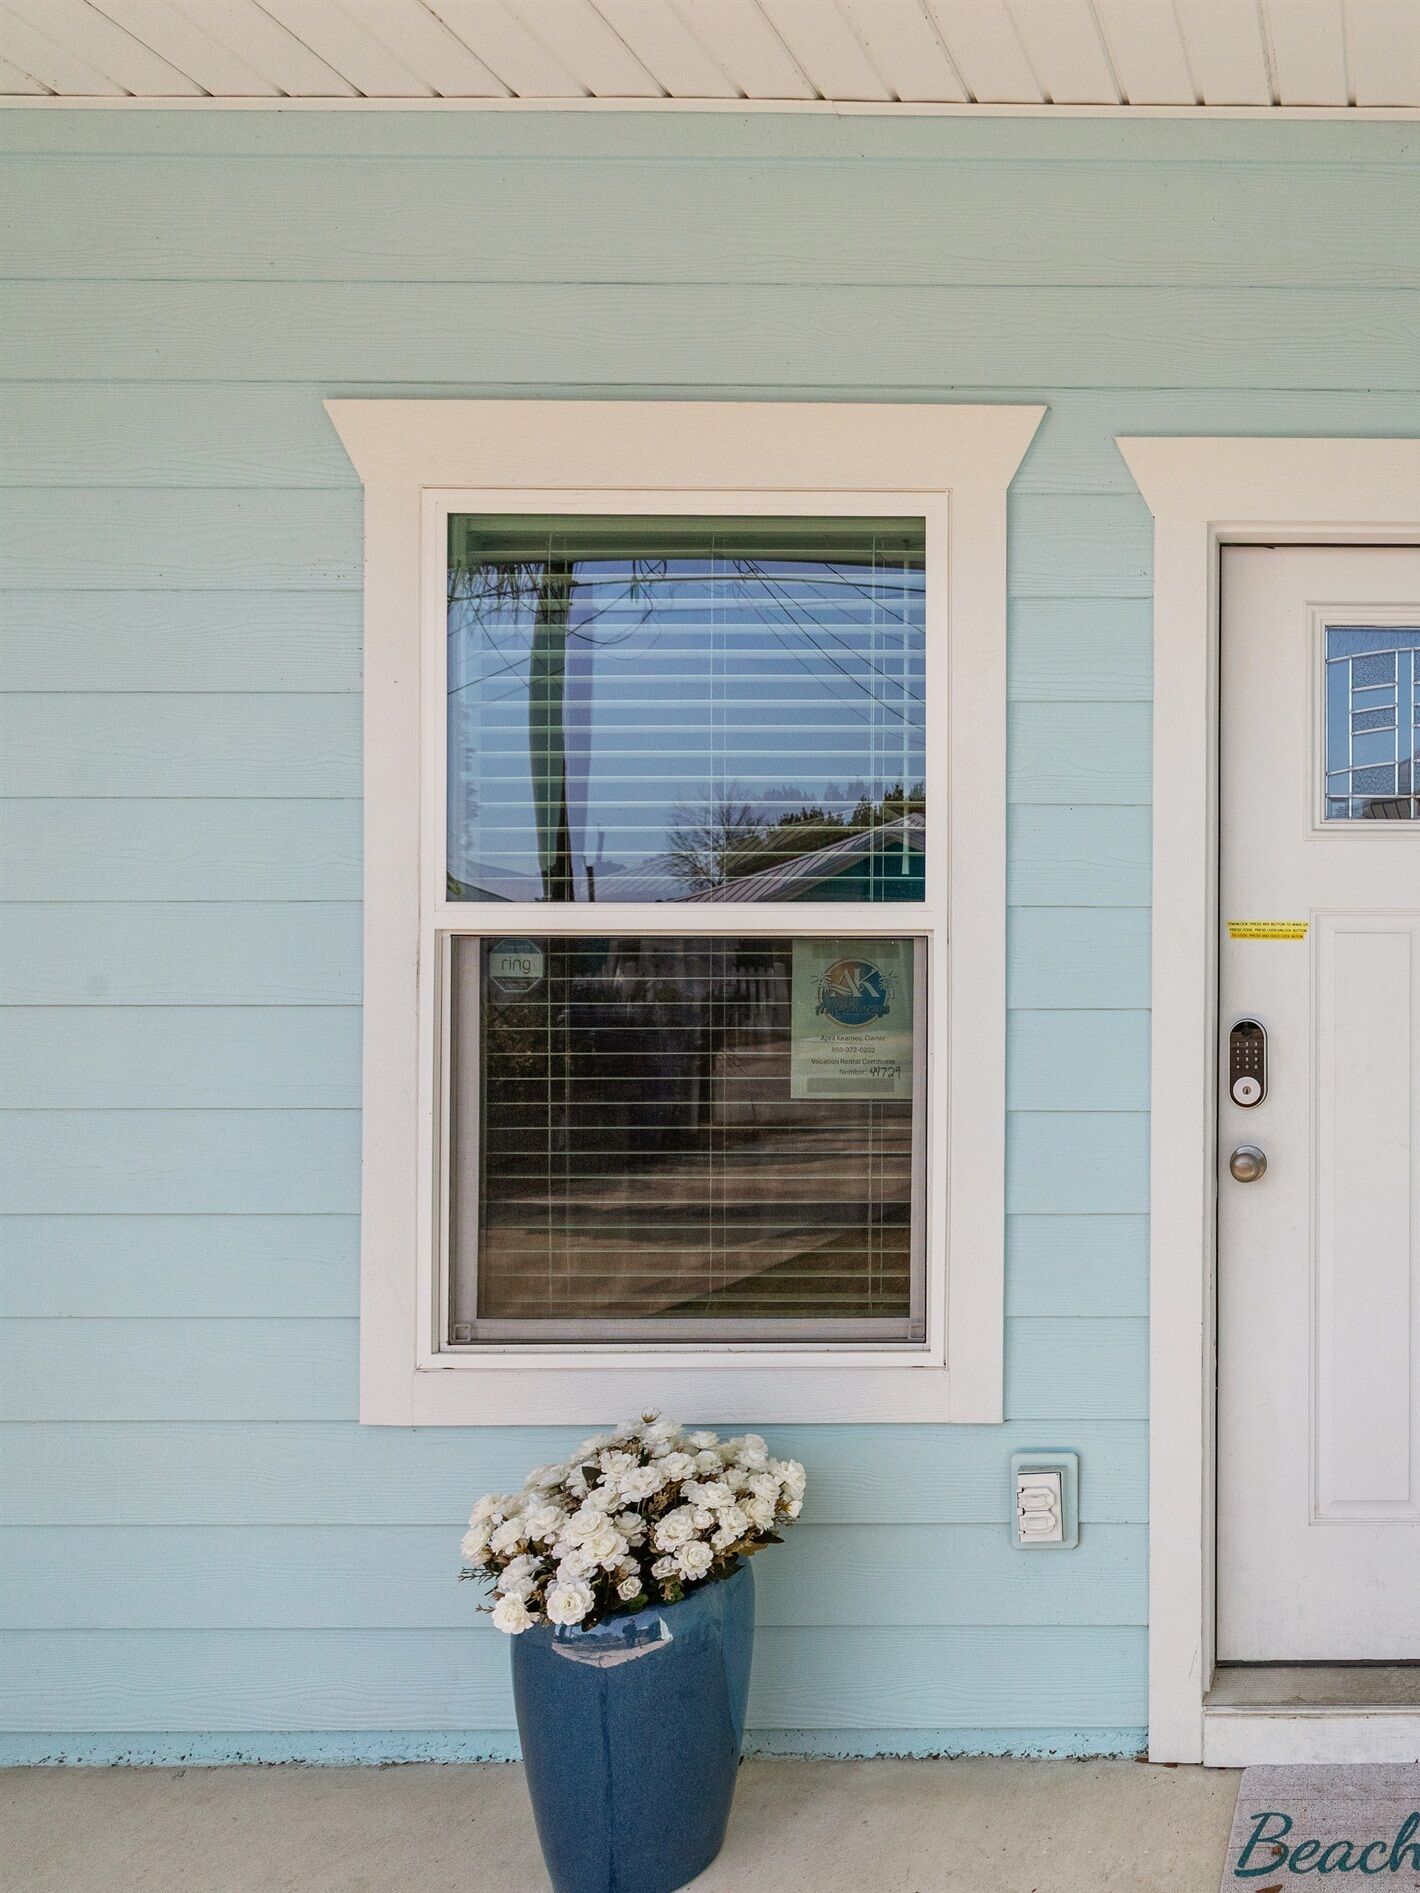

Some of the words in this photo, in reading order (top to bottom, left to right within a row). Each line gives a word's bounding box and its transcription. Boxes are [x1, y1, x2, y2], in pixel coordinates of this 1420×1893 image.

[501, 956, 531, 975] ring
[829, 968, 881, 998] AK
[810, 1057, 840, 1065] Vacation
[840, 1057, 861, 1065] Rental
